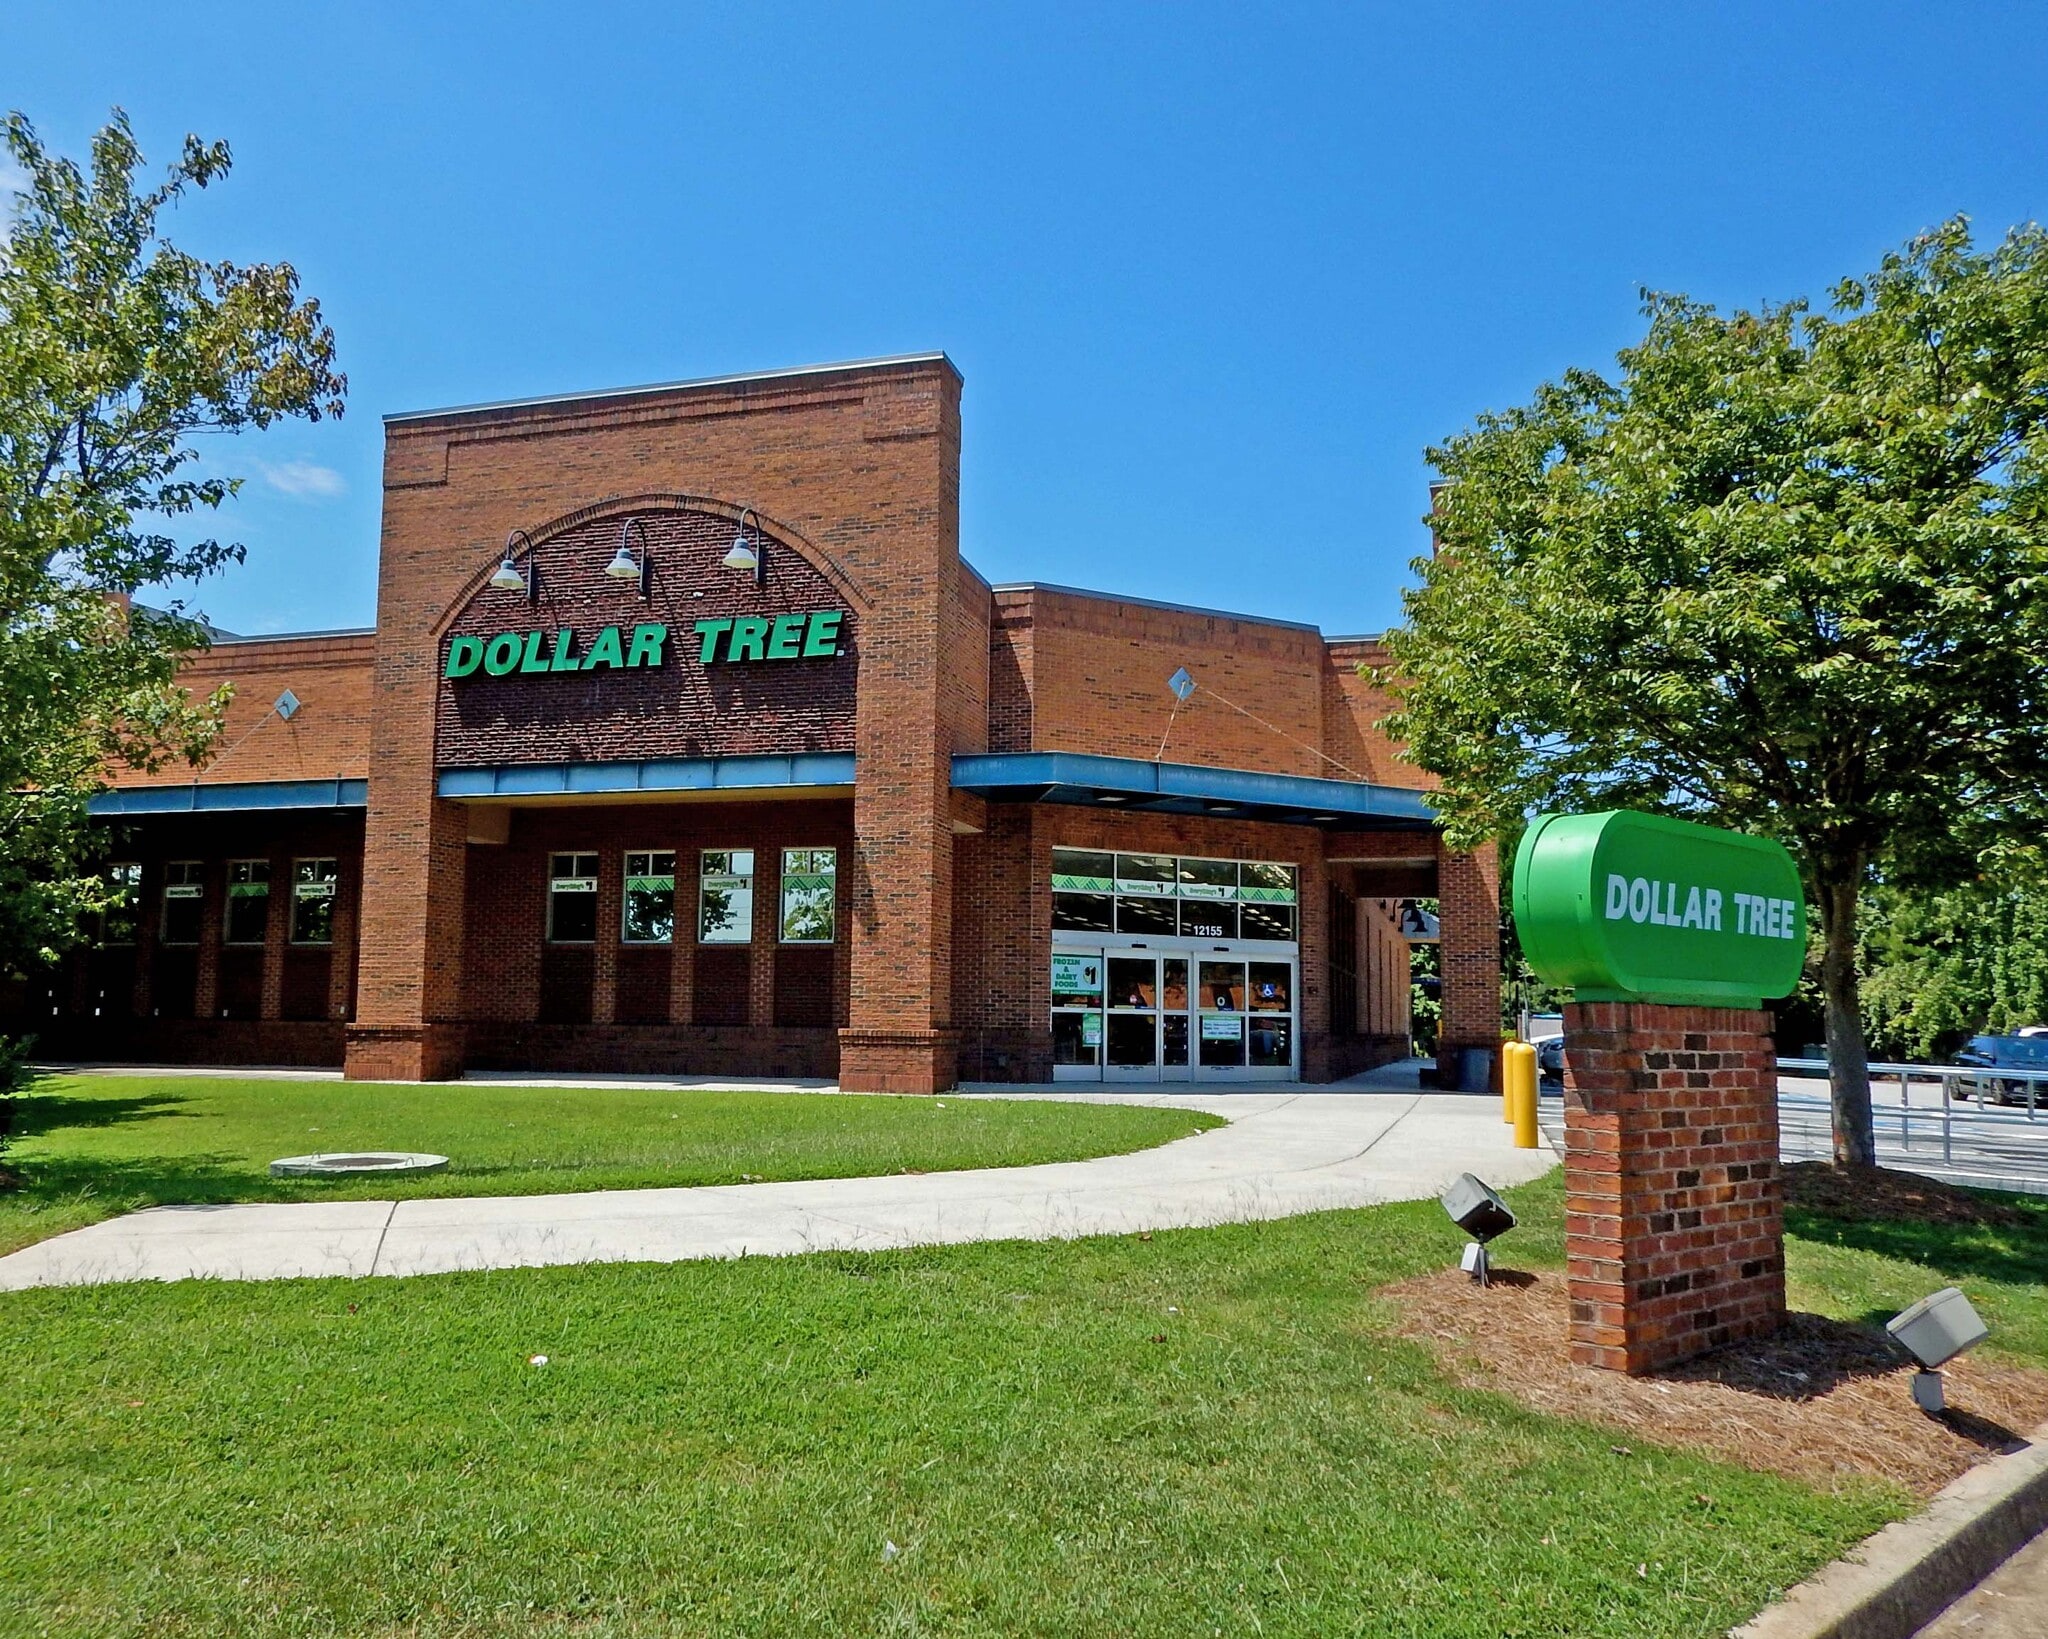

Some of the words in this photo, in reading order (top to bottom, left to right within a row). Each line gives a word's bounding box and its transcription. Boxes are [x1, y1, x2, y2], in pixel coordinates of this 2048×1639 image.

[445, 623, 667, 678] DOLLAR
[695, 611, 842, 664] TREE
[1193, 925, 1223, 937] 12155
[1605, 874, 1722, 931] DOLLAR
[1734, 892, 1796, 940] TREE
